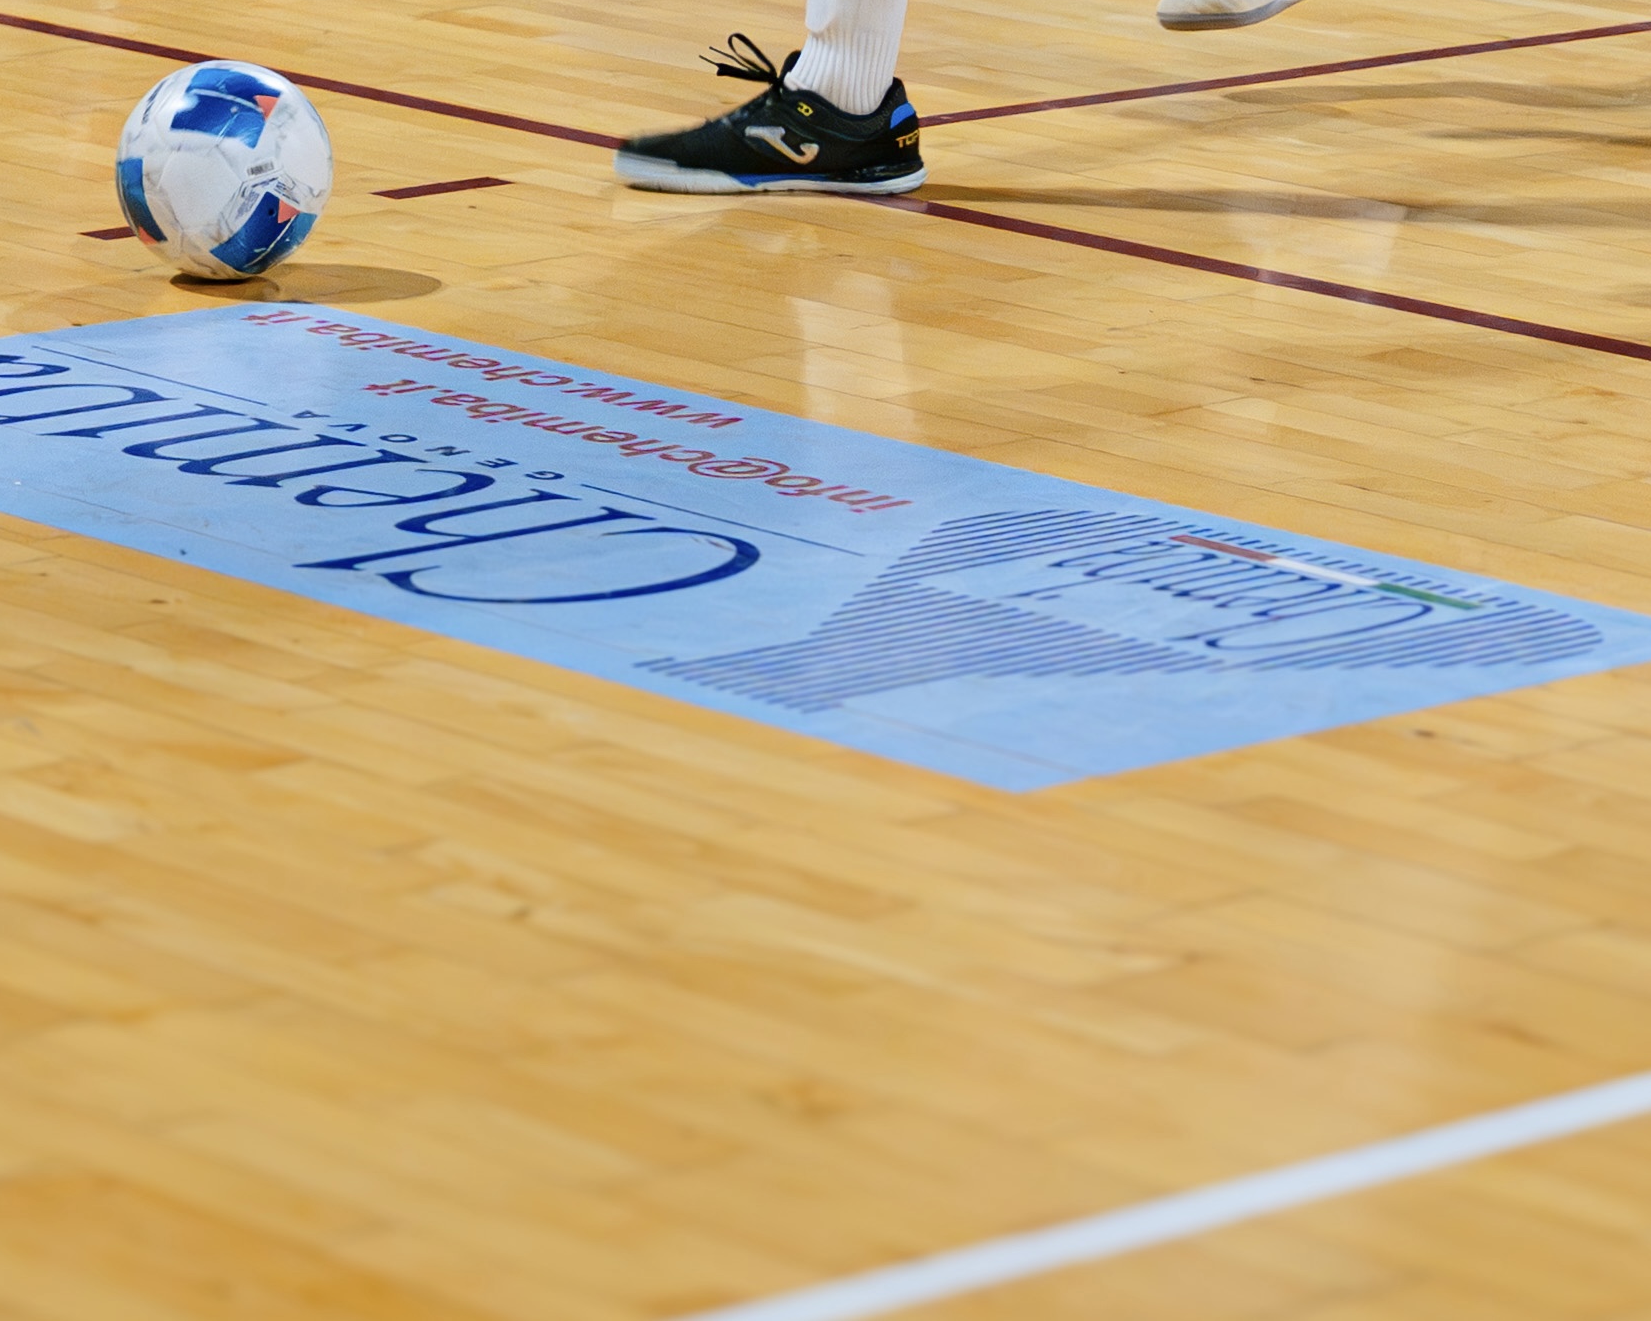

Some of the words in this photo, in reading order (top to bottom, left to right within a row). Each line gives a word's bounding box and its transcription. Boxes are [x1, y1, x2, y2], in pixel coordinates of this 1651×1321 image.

[240, 310, 745, 433] www.chemiba.it
[294, 408, 569, 483] GENOVA
[363, 378, 916, 514] info@chemiba.it
[1016, 539, 1435, 651] Chemiba
